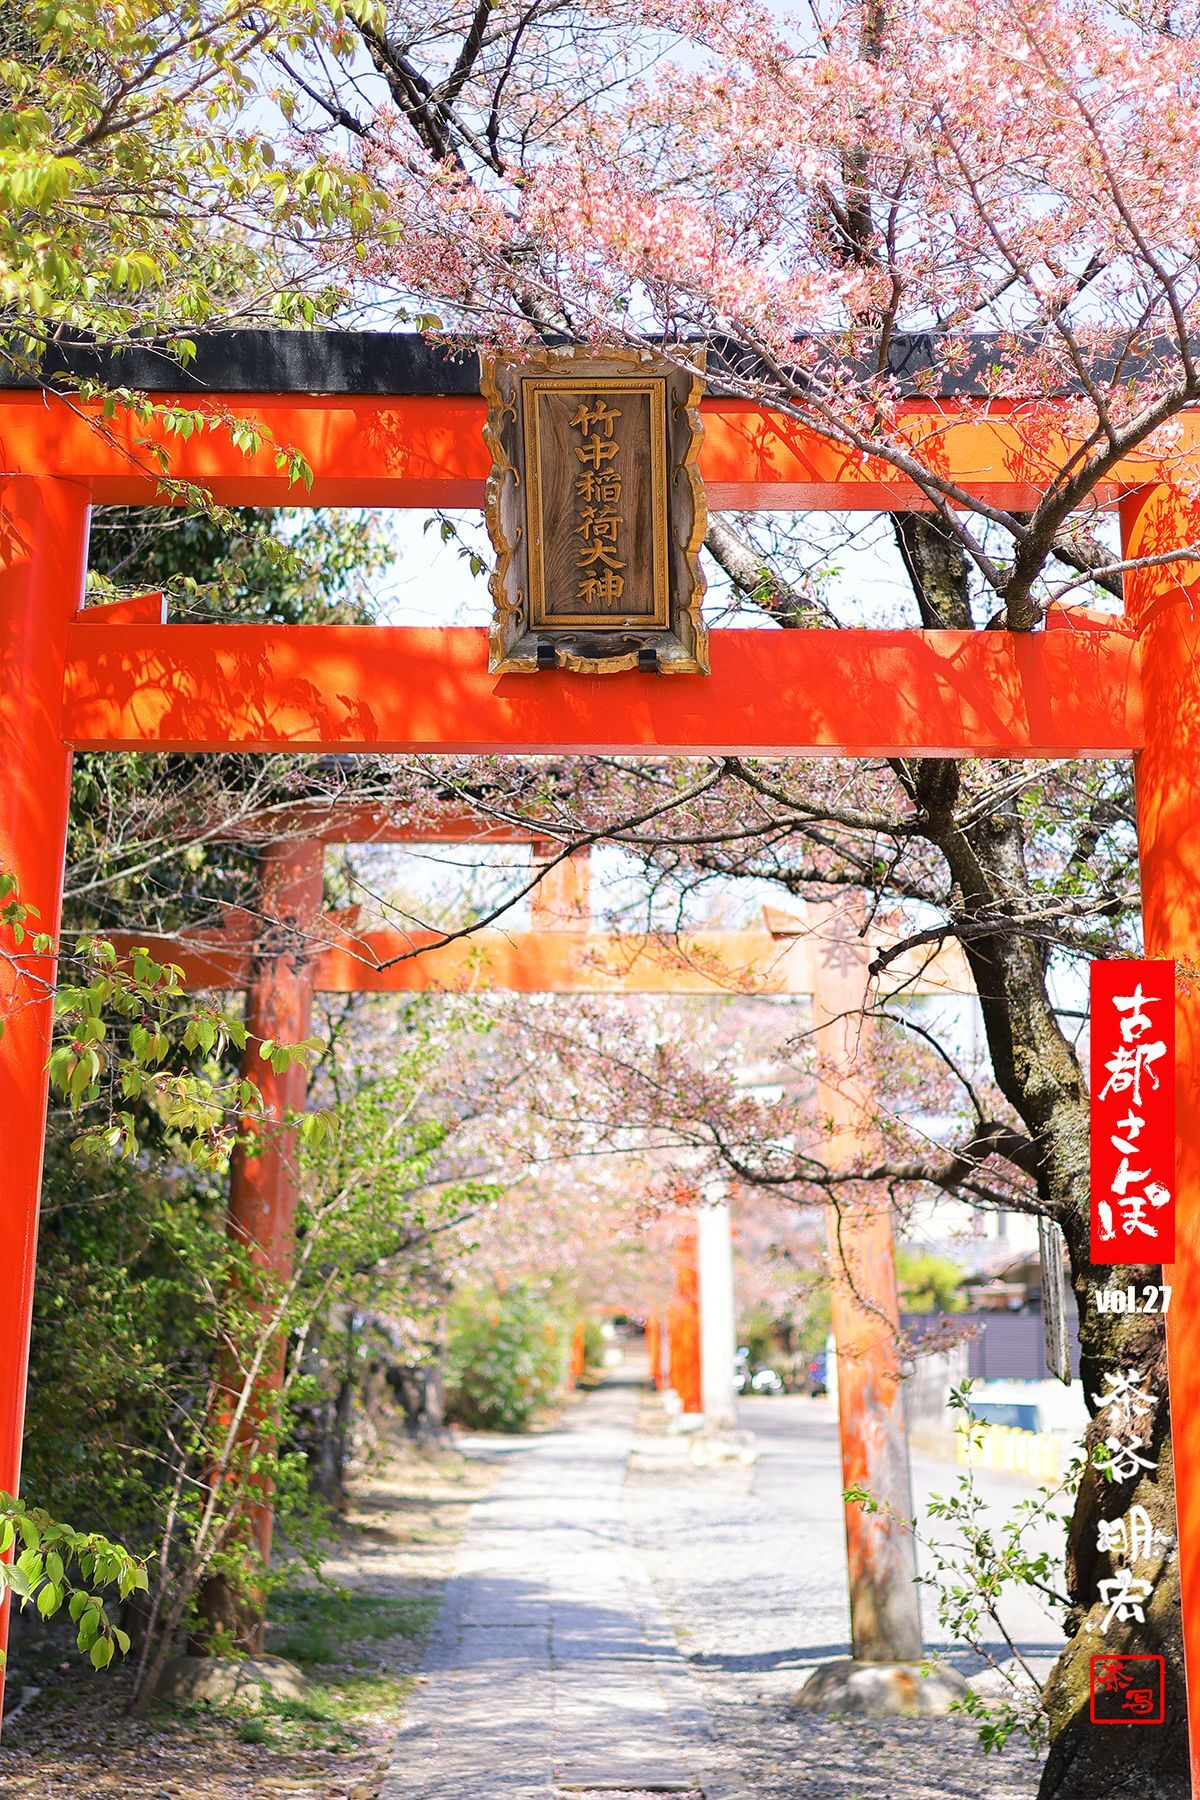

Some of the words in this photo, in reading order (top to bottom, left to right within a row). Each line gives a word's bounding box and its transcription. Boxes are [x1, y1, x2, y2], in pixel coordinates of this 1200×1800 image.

[569, 399, 627, 607] 竹中稲荷大神
